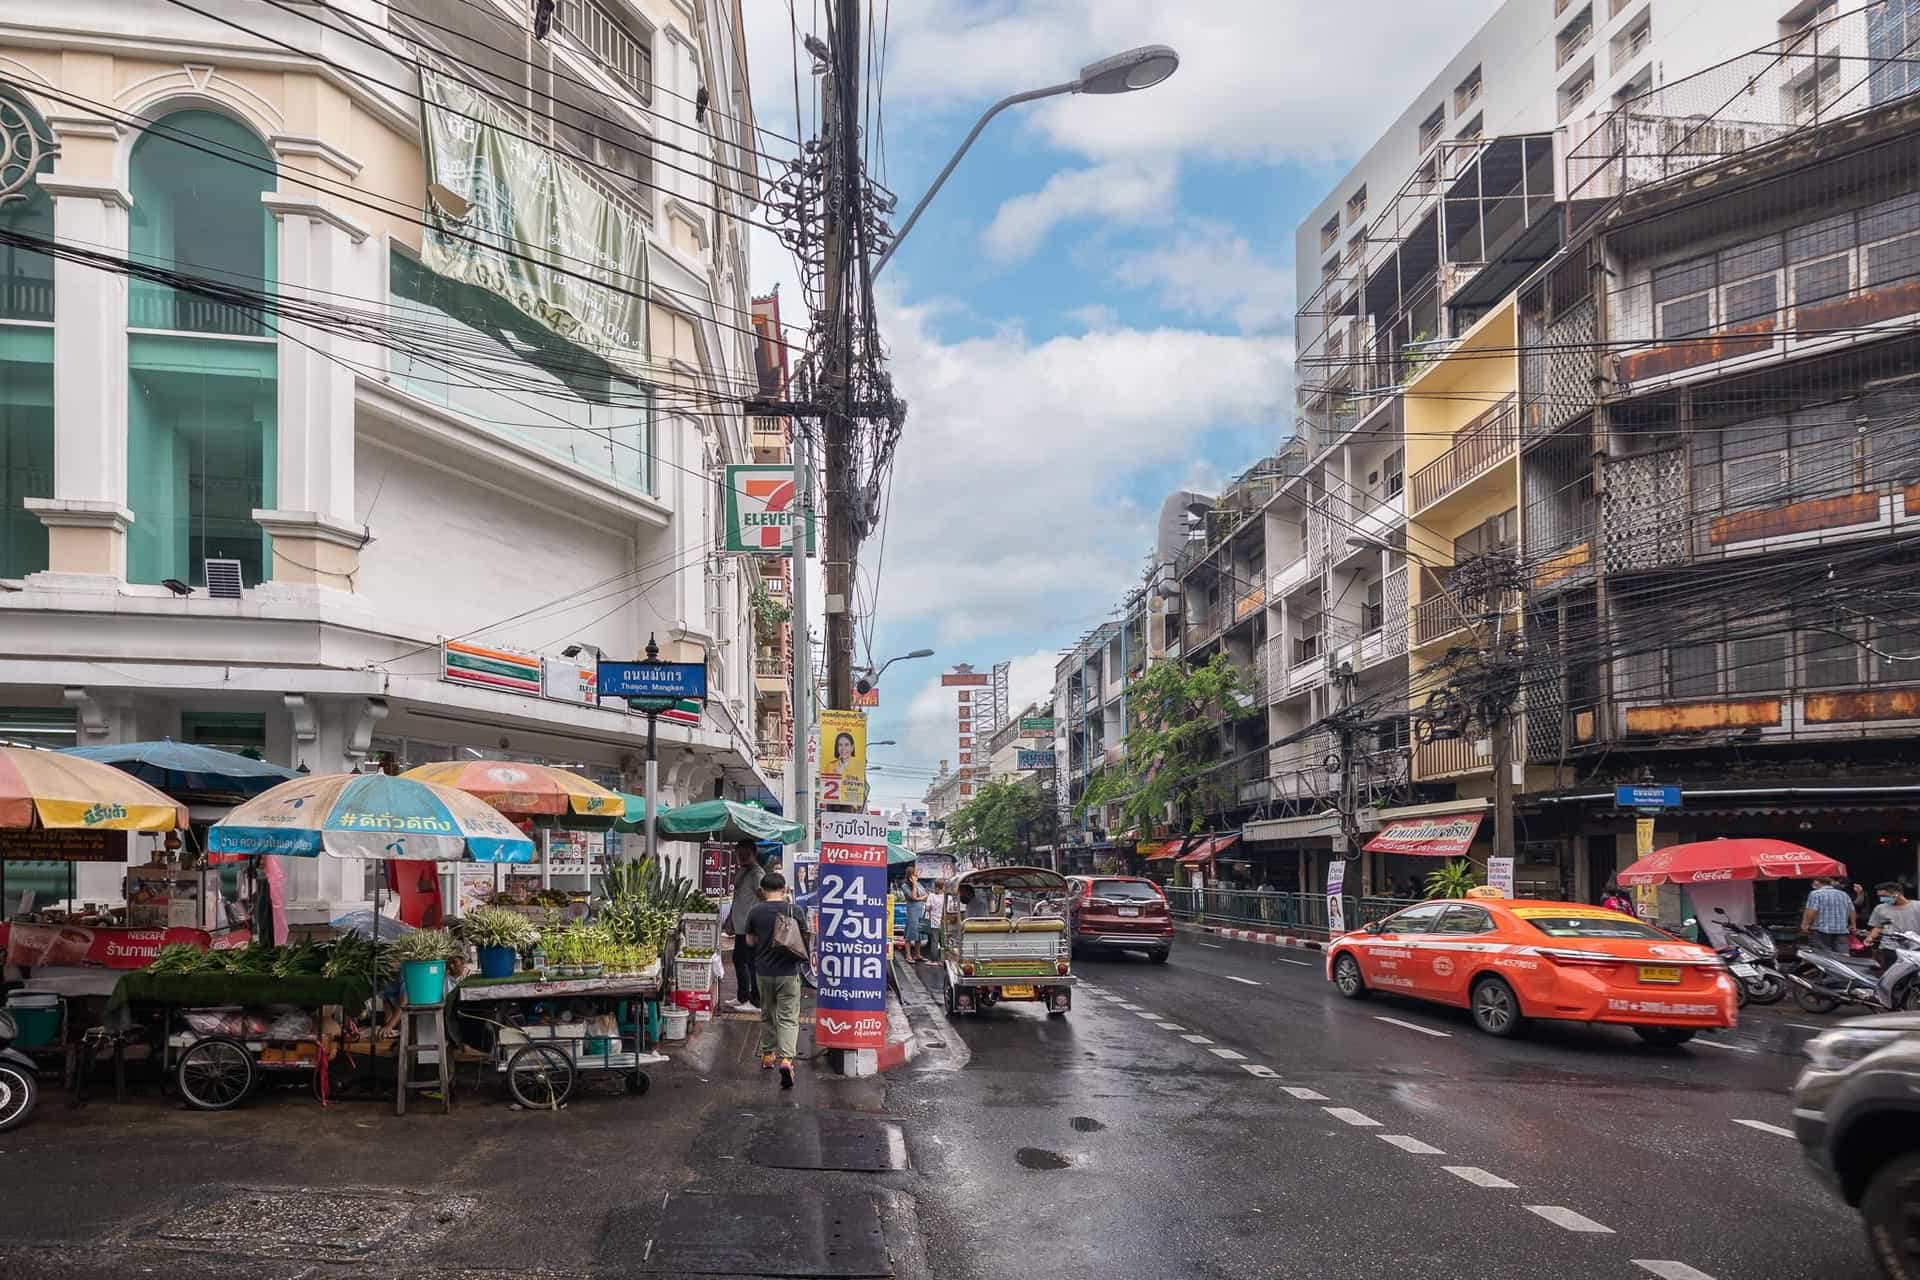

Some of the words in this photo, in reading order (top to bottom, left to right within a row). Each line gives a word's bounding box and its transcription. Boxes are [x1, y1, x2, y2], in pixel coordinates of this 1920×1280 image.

[623, 667, 682, 681] ถนนมังกร
[621, 682, 648, 690] Thanon
[652, 683, 684, 692] Mangkon
[824, 781, 839, 800] 2
[340, 812, 451, 831] #ดีทั่วดีถึง
[835, 818, 887, 839] ภูมิใจไทย
[1692, 870, 1732, 881] Coca-Cola
[822, 874, 867, 905] 24
[821, 939, 882, 954] เราพร้อม
[821, 955, 882, 987] ดูแล
[820, 988, 881, 1000] คนกรุงเทพฯ
